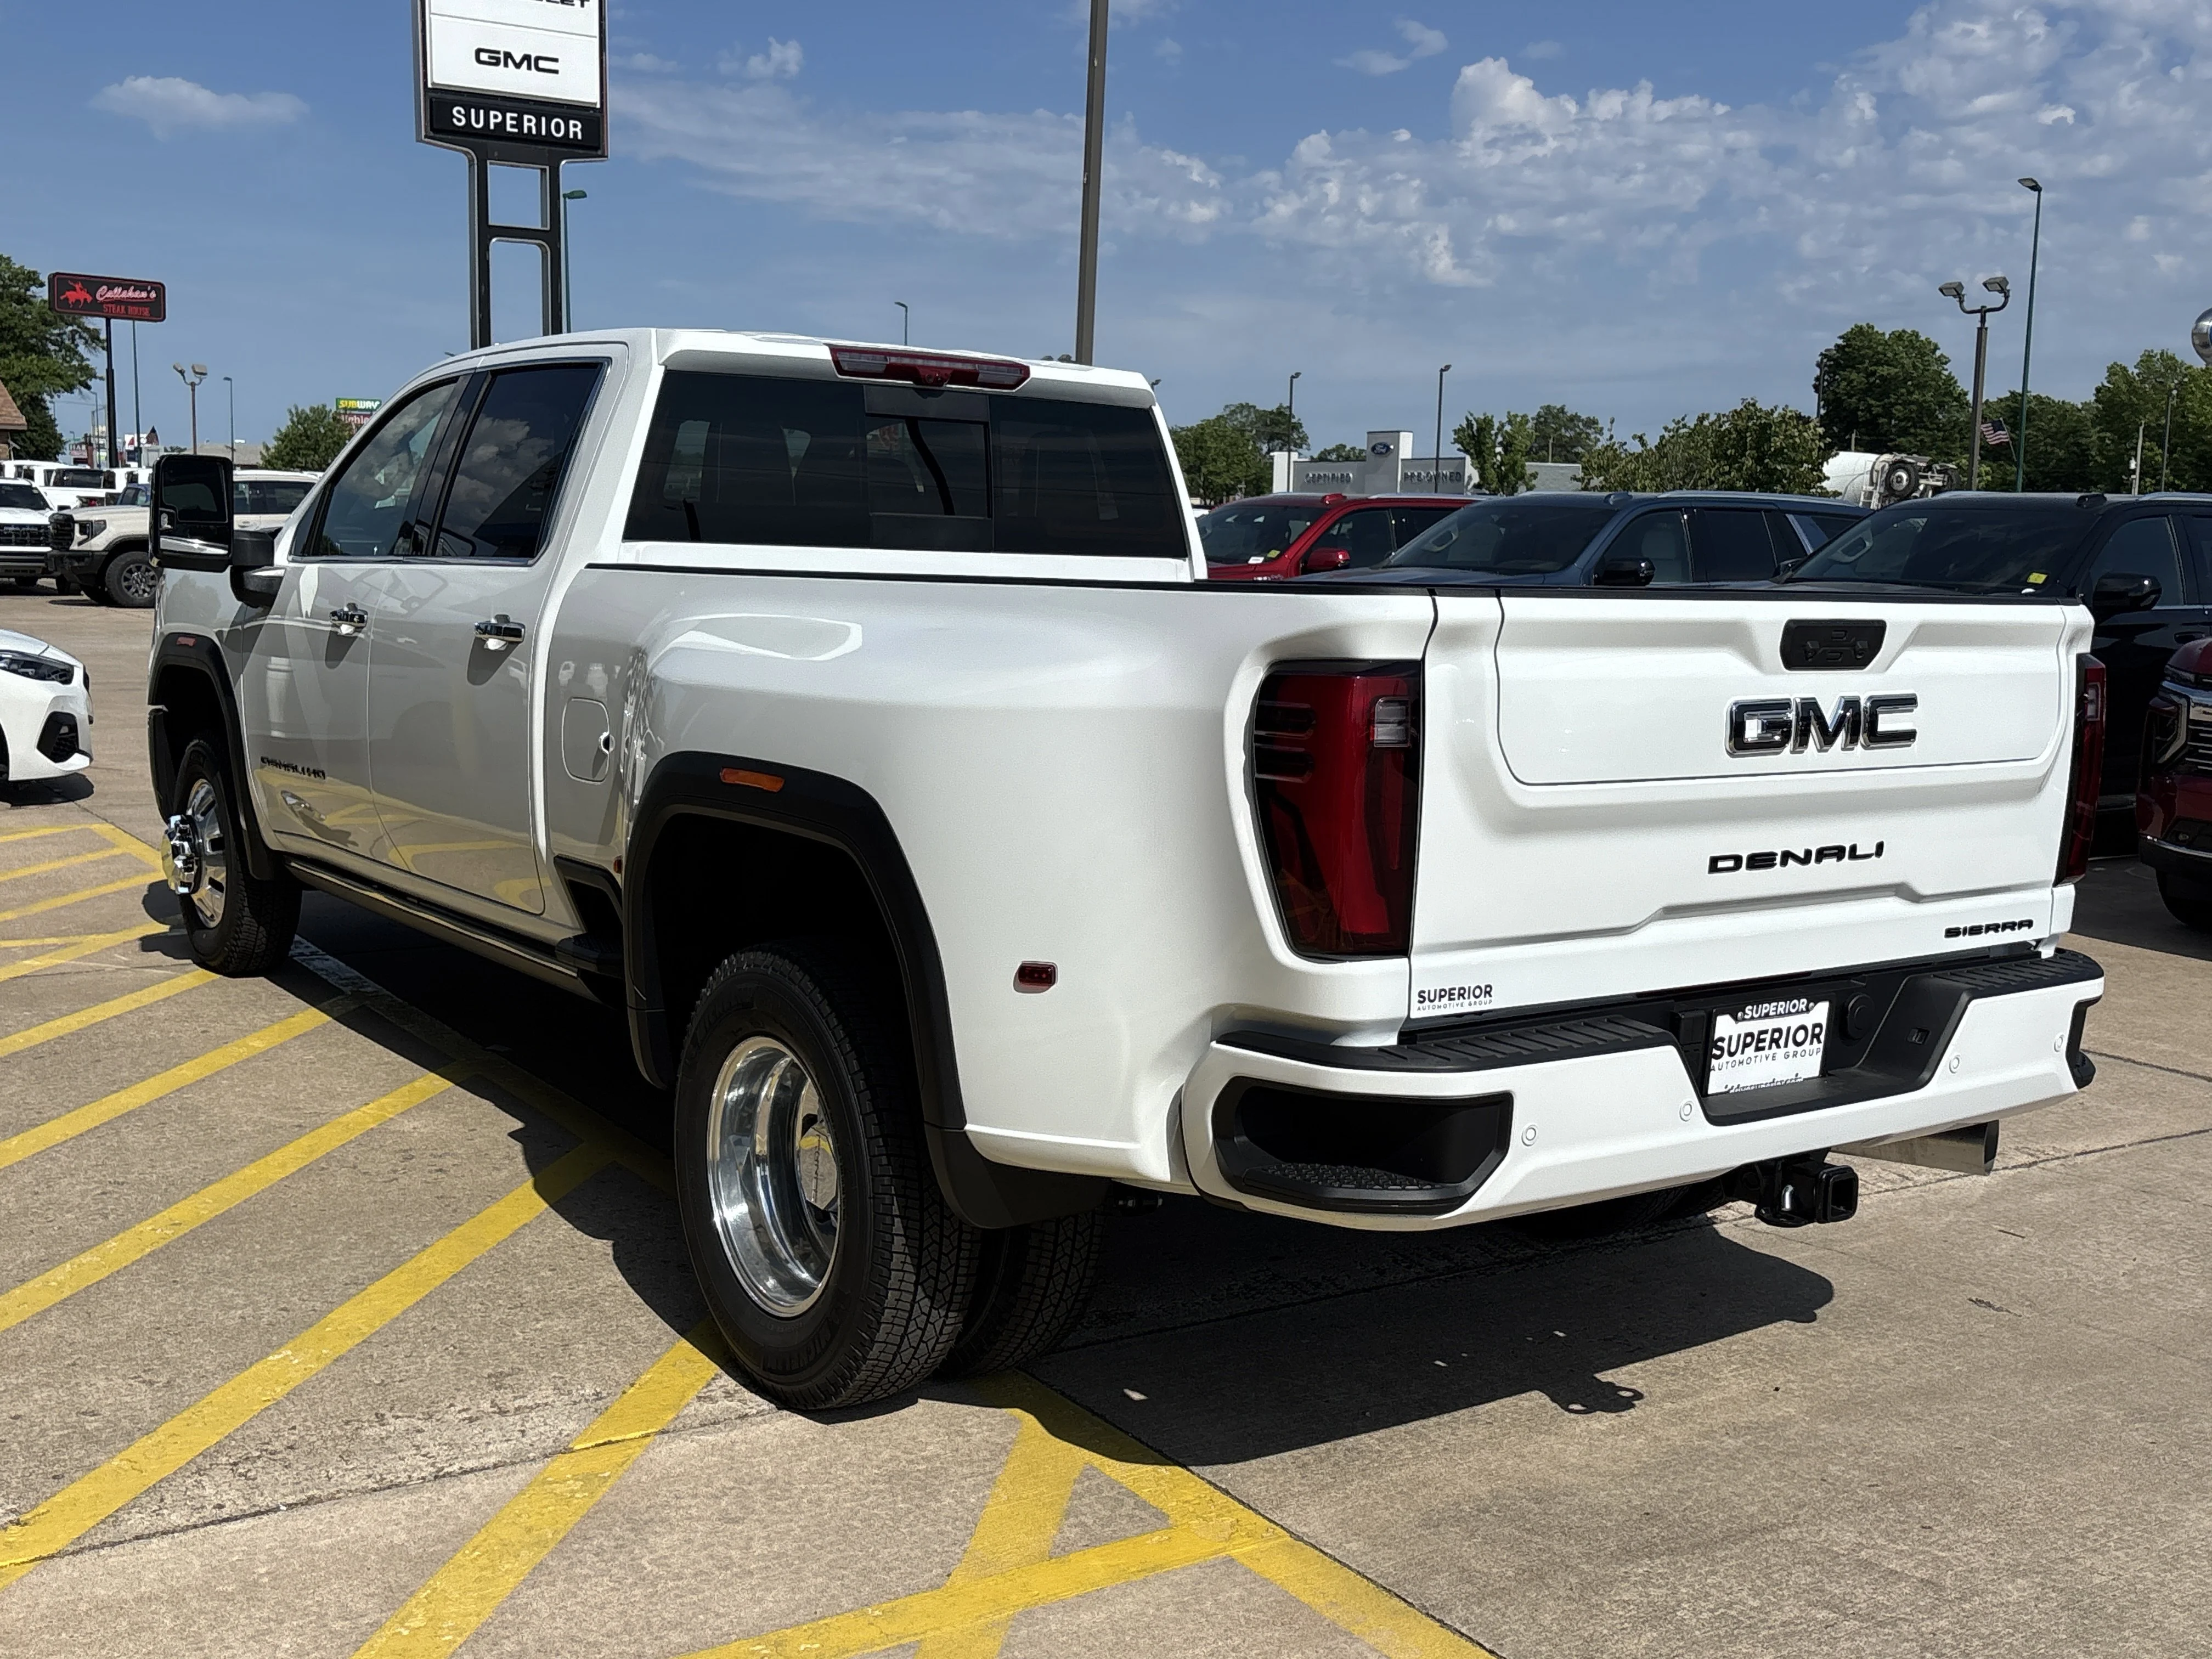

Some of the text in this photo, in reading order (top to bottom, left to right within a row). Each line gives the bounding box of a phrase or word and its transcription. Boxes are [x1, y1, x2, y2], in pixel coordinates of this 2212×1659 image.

[475, 47, 560, 75] GMC
[452, 106, 583, 140] SUPERIOR
[95, 285, 157, 301] Callahan's
[103, 304, 126, 314] STEAK
[339, 399, 380, 409] SUBWAY
[1725, 693, 1918, 758] GMC
[1708, 840, 1884, 874] DENALI
[1944, 919, 2033, 938] SIERRA
[1417, 984, 1493, 1004] SUPERIOR
[1417, 1002, 1464, 1011] AUTOMOTIVE
[1744, 998, 1807, 1019] SUPERIOR
[1712, 1023, 1823, 1060] SUPERIOR
[1710, 1047, 1821, 1071] AUTOMOTIVE GROUP
